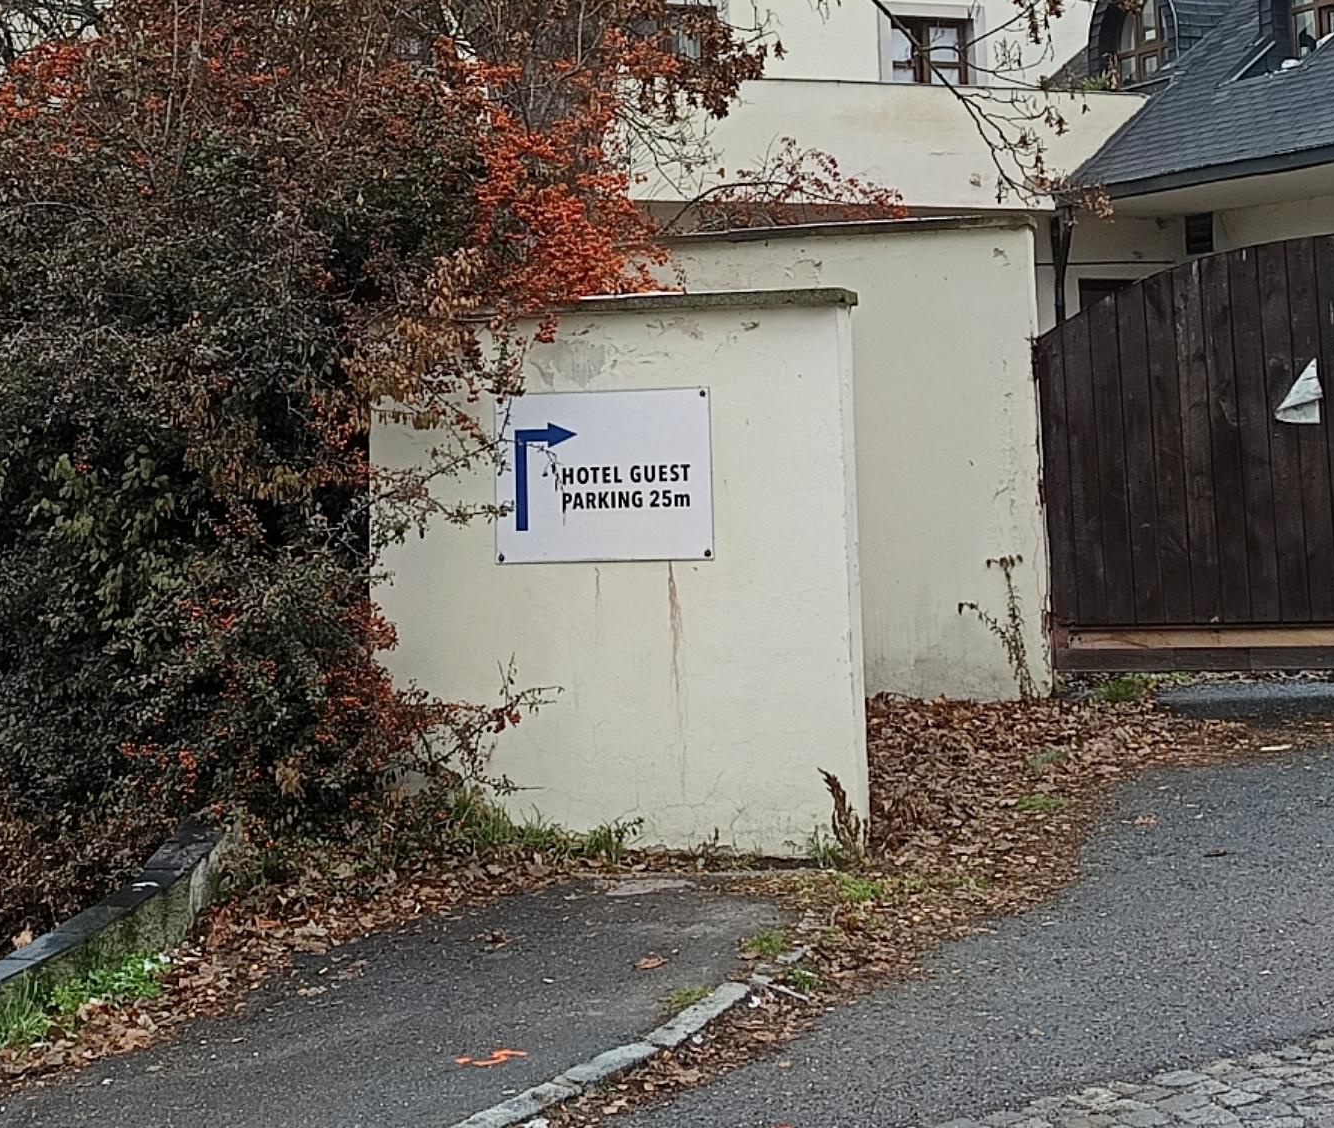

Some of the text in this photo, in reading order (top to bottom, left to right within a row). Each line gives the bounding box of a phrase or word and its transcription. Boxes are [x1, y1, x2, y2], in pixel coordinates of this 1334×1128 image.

[562, 464, 691, 485] HOTEL GUEST
[562, 490, 691, 510] PARKING 25m
